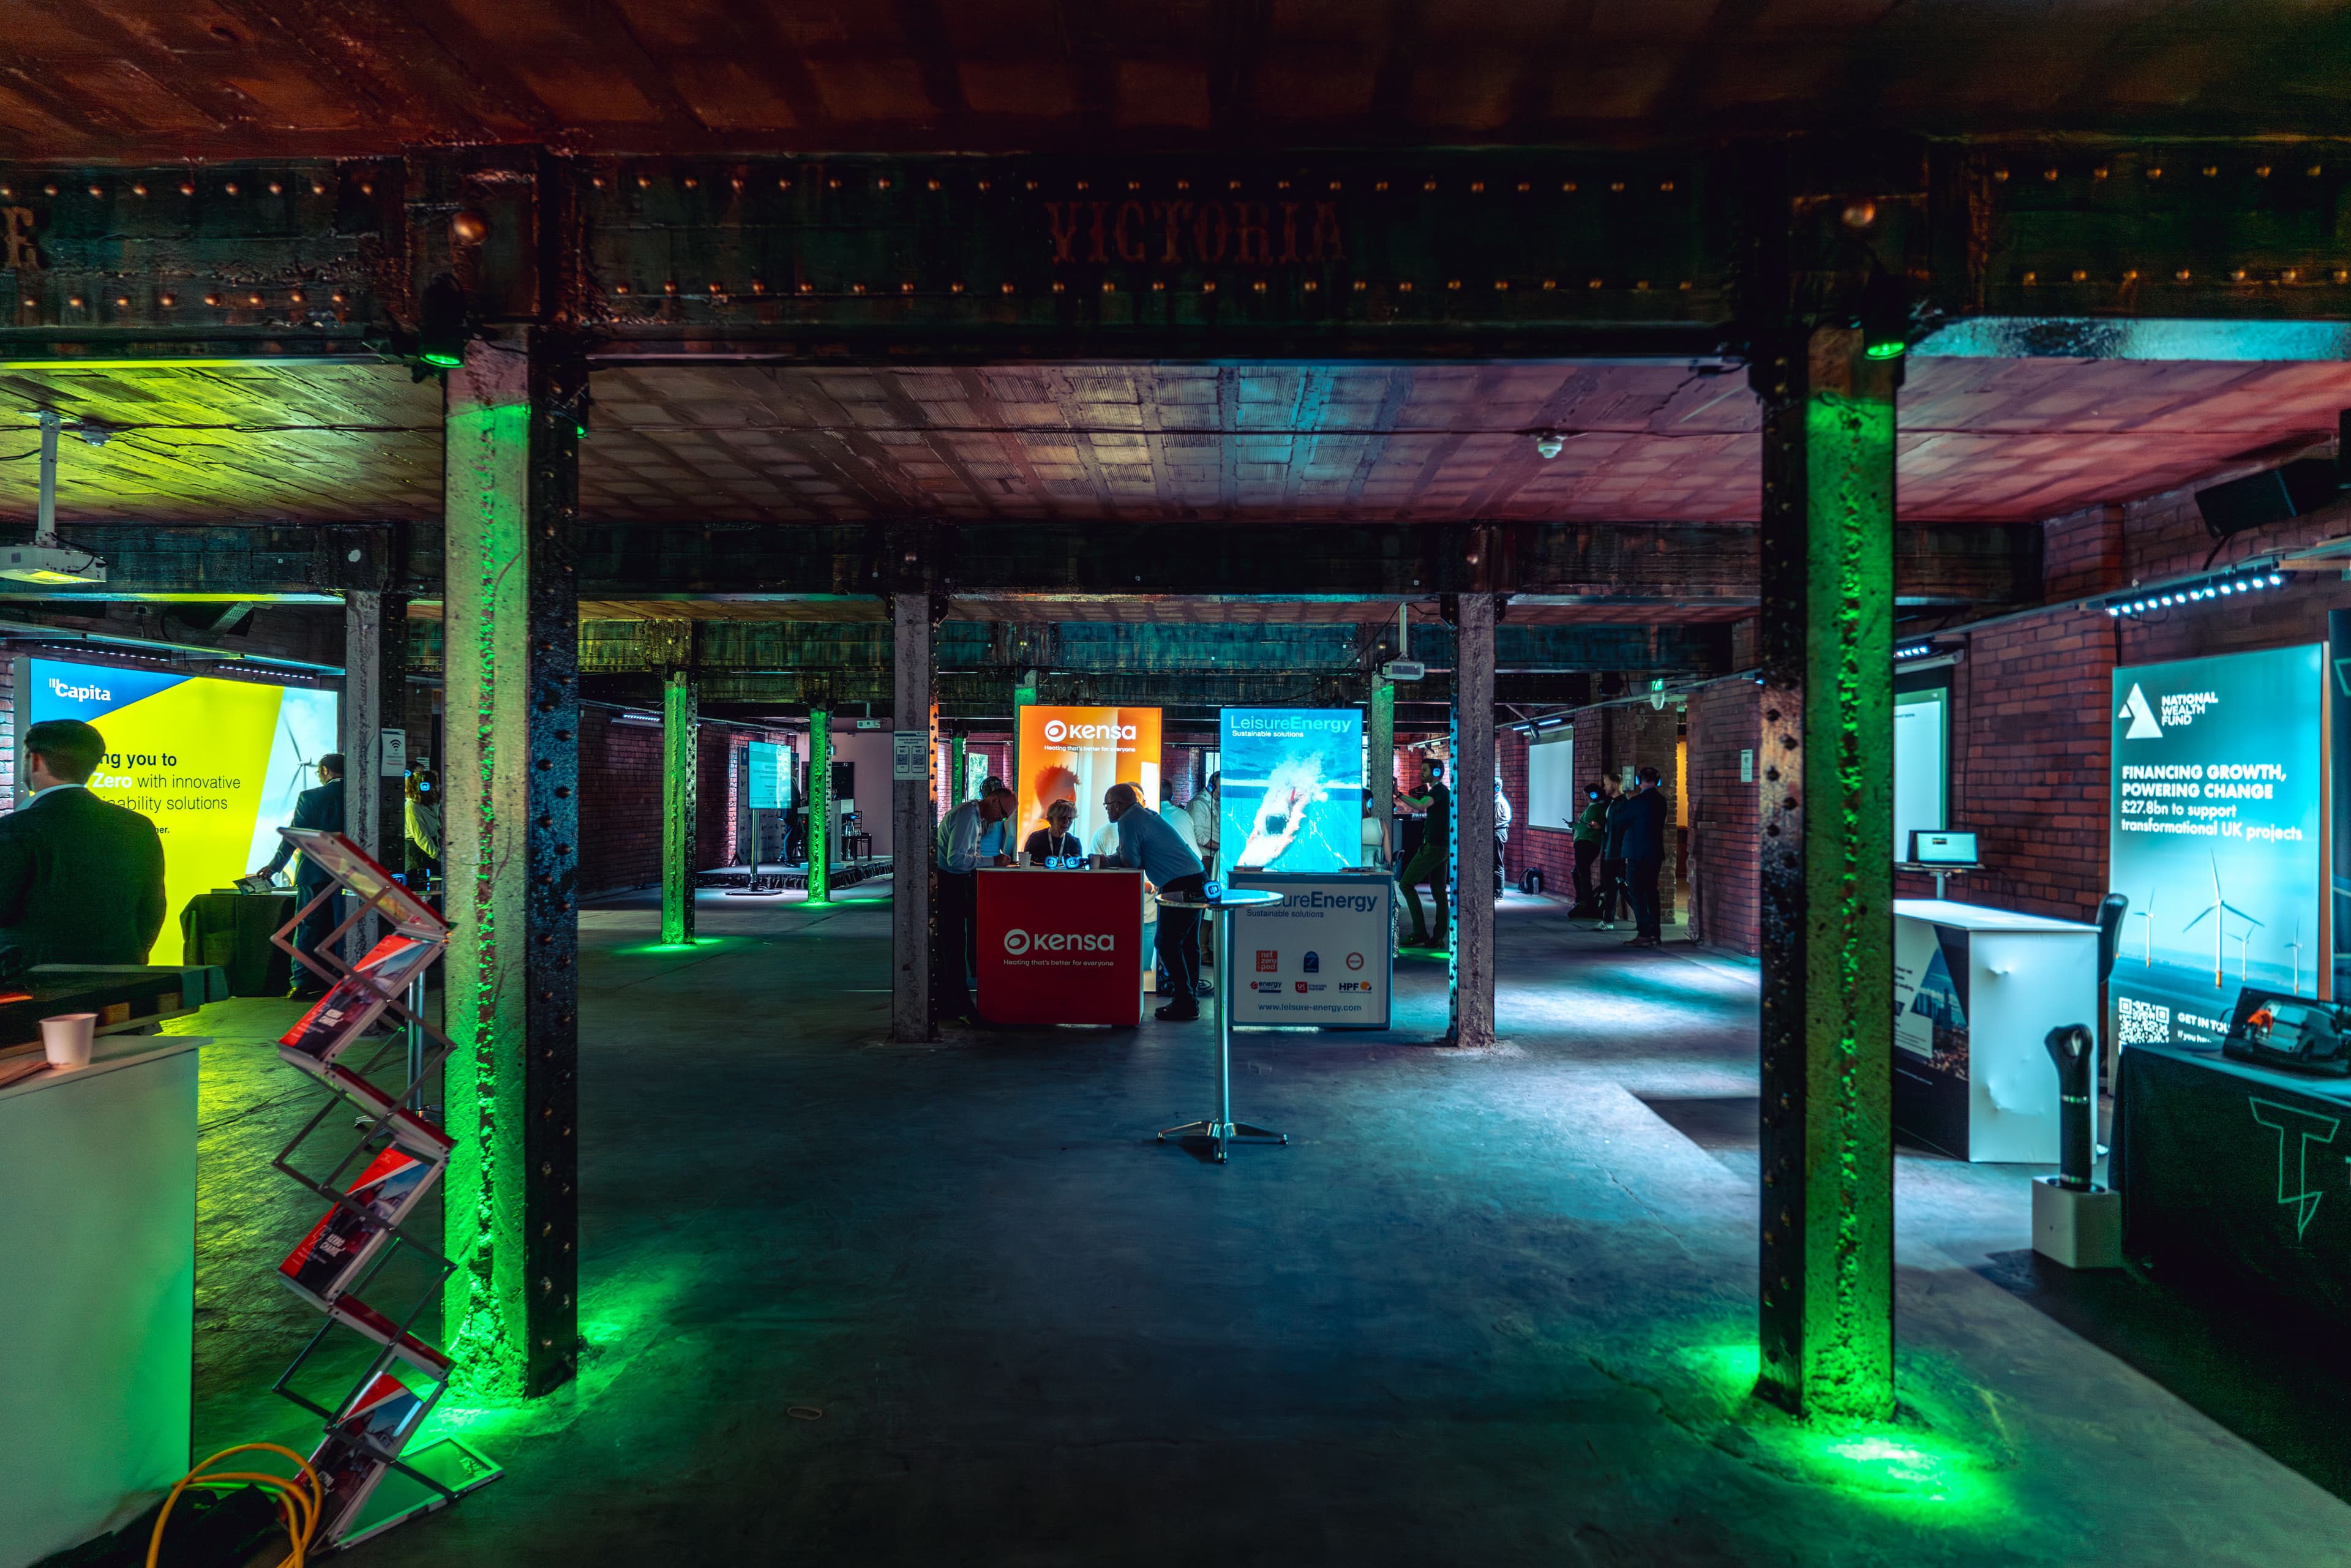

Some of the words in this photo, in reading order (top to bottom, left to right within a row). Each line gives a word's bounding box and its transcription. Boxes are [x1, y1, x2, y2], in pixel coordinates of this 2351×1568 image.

[1044, 200, 1347, 265] VICTORIA
[54, 683, 111, 702] Capita
[2161, 691, 2219, 706] NATIONAL
[2161, 704, 2205, 716] WEALTH
[1231, 715, 1351, 733] LeisureEnergy
[2161, 715, 2192, 726] FUND
[127, 754, 156, 768] you
[162, 752, 177, 767] to
[92, 772, 132, 789] Zero
[137, 774, 167, 789] with
[173, 774, 241, 789] innovative
[2122, 765, 2203, 780] FINANCING
[2207, 763, 2287, 782] GROWTH,
[2122, 782, 2200, 798] POWERING
[2204, 783, 2273, 799] CHANGE
[167, 797, 228, 809] solutions
[2121, 800, 2169, 815] £27.8bn
[2172, 803, 2184, 816] to
[2188, 804, 2237, 820] support
[2121, 817, 2218, 836] transformational
[2221, 821, 2243, 838] UK
[2246, 823, 2303, 843] projects
[1291, 910, 1324, 918] solutions
[1258, 1003, 1362, 1012] www.leisure-energy.com
[2178, 1012, 2197, 1026] GET
[2197, 1016, 2209, 1029] IN
[2183, 1033, 2196, 1042] you
